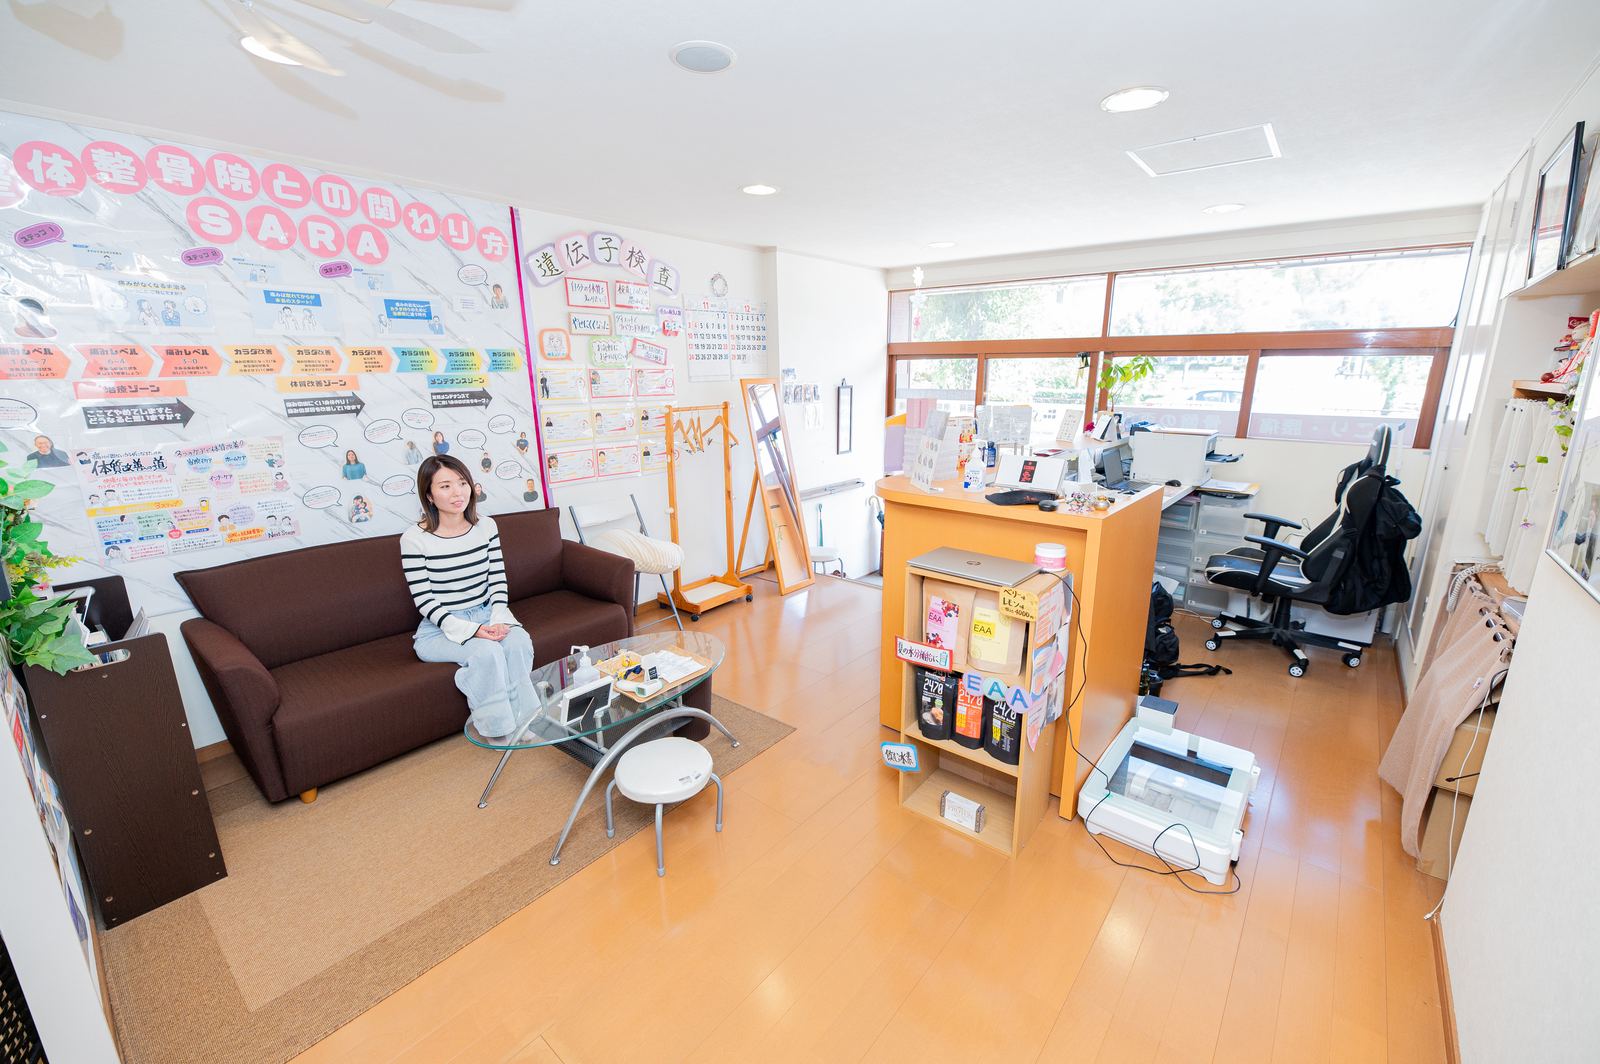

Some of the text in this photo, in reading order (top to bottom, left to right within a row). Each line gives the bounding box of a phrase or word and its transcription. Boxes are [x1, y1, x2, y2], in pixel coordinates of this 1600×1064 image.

[197, 205, 382, 258] SARA
[536, 237, 673, 292] 遺伝子検査
[104, 385, 160, 394] 治療ゾーン
[290, 379, 347, 388] 体質改善ゾーン
[928, 612, 943, 623] EAA
[973, 625, 992, 635] EAA
[923, 678, 944, 695] 2470
[967, 674, 1028, 709] EAA
